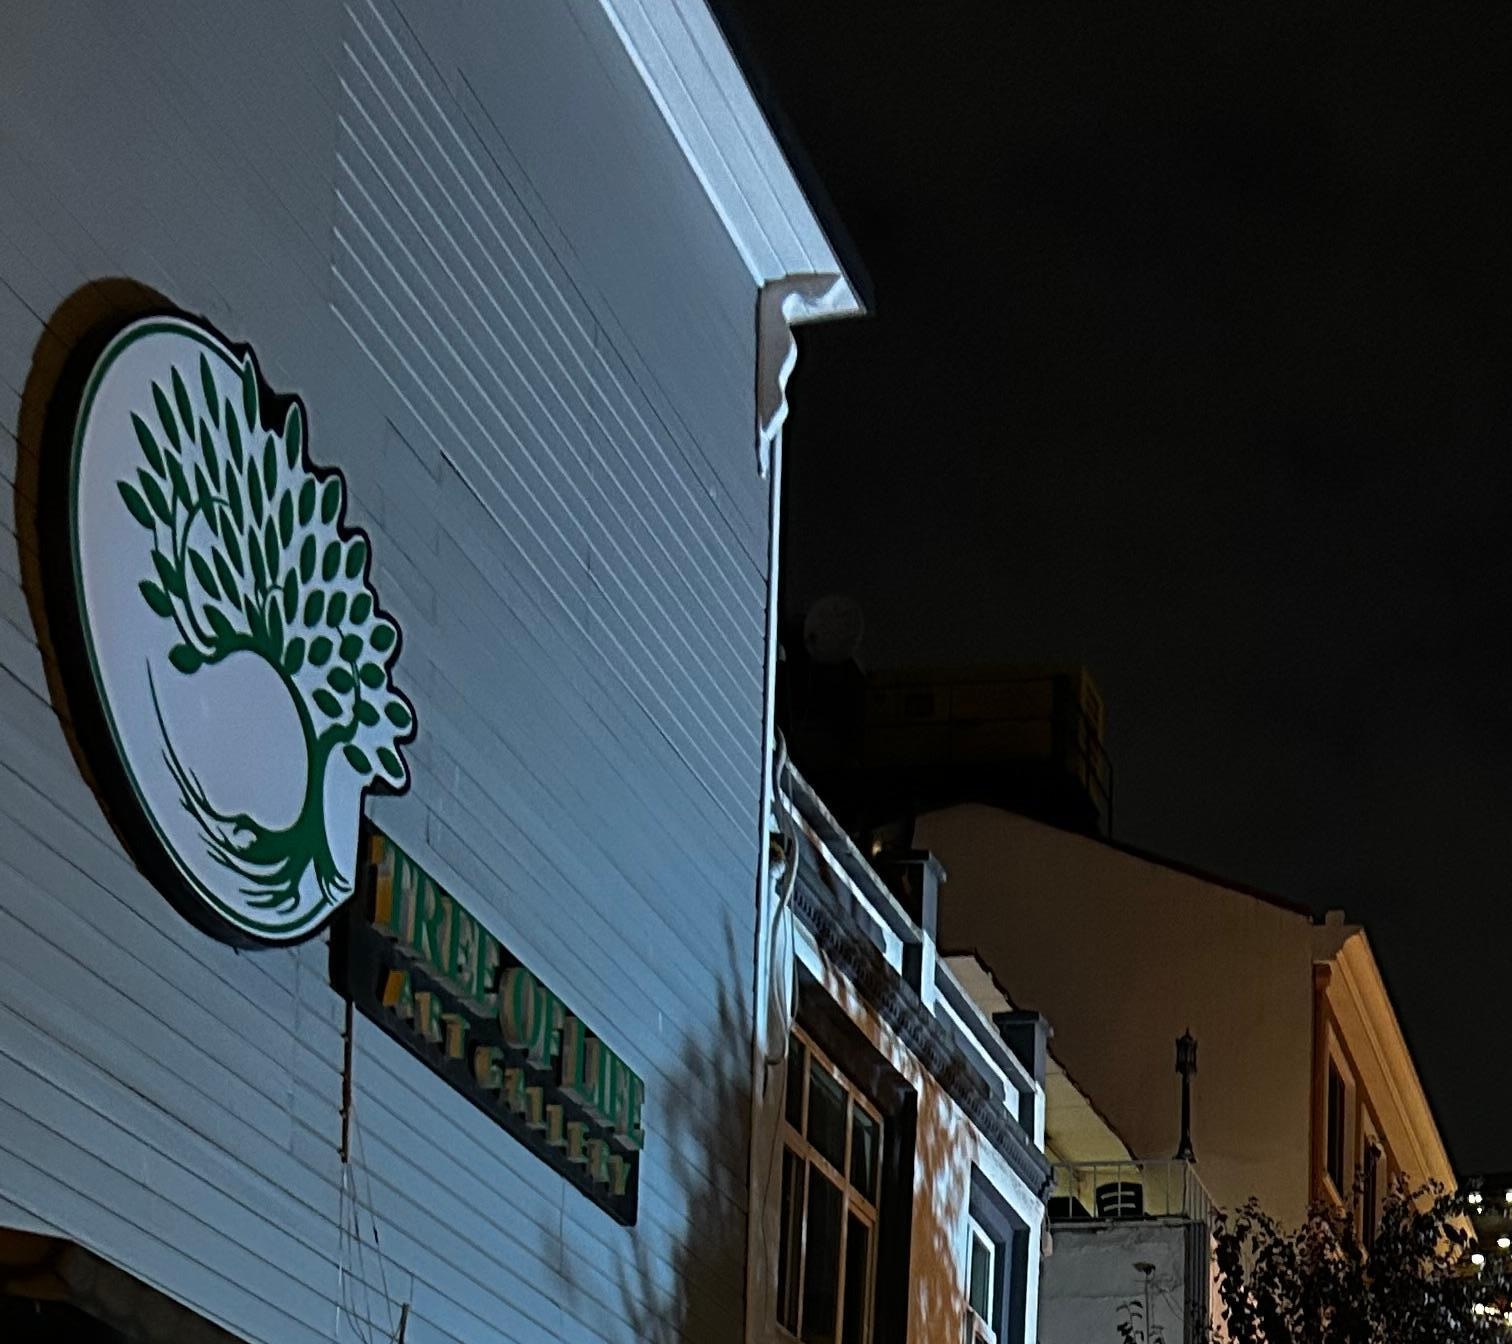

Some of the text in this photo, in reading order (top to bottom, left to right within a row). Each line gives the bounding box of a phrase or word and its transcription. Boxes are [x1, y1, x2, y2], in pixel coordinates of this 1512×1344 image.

[370, 835, 645, 1151] TREE OF LIFE
[382, 969, 632, 1196] ART GALLERY
